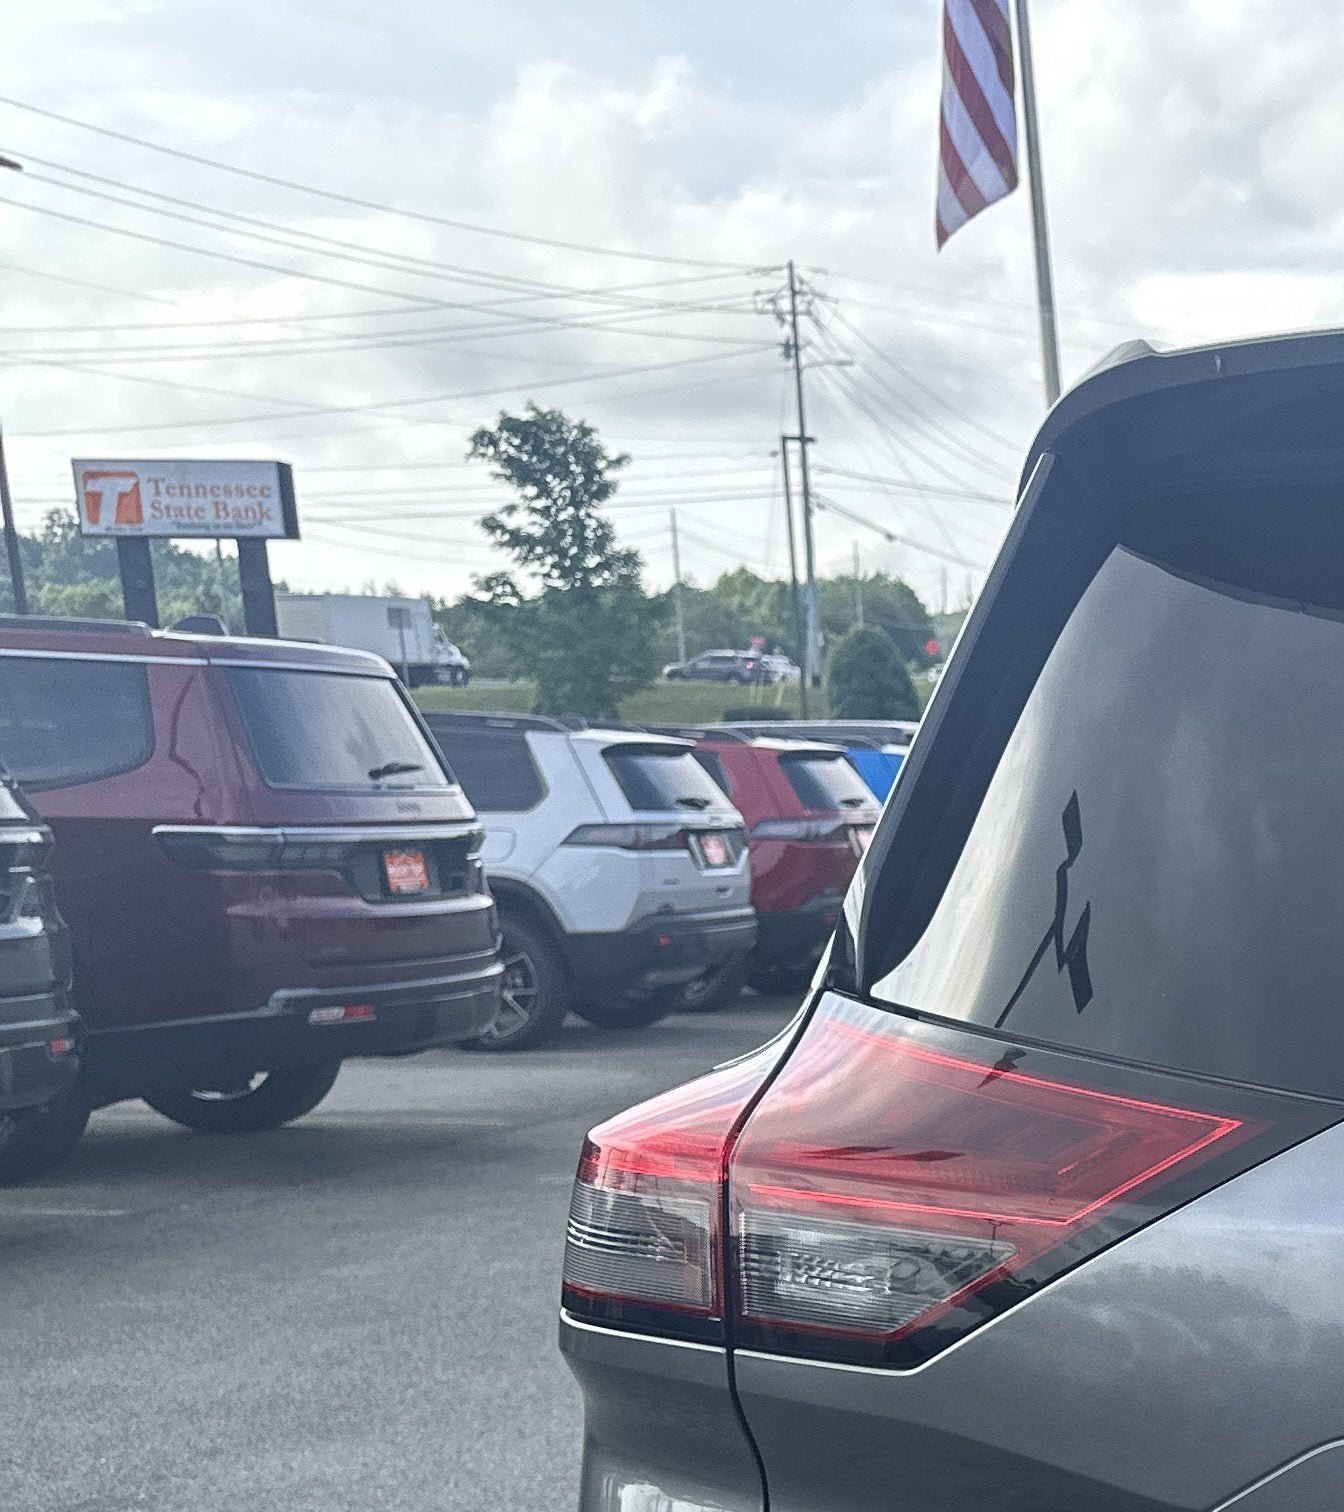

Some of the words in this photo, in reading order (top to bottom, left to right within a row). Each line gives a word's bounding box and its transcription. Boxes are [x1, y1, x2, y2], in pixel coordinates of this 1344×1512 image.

[147, 477, 273, 499] Tennessee
[150, 500, 206, 521] State
[213, 501, 273, 522] Bank
